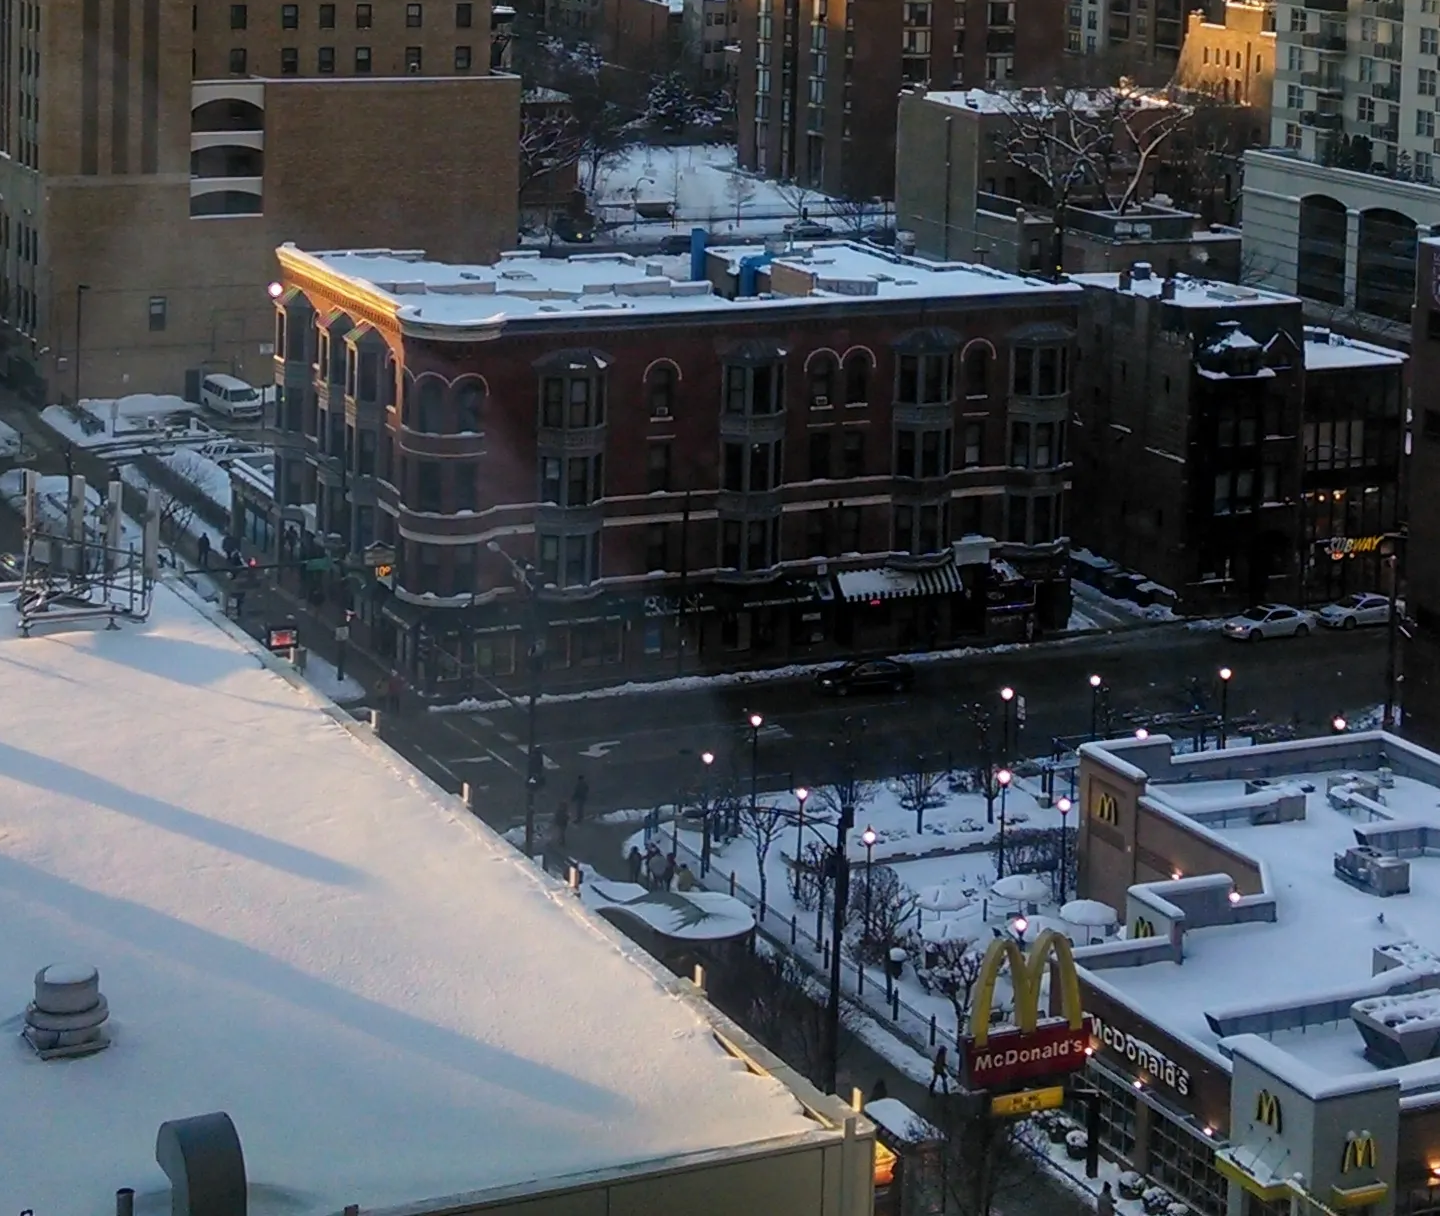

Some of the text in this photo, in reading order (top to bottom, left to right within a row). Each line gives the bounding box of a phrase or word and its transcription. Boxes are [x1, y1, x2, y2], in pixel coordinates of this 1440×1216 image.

[1330, 534, 1385, 553] SUBWAY
[974, 1038, 1084, 1072] McDonald's
[1090, 1016, 1190, 1096] McDonald's
